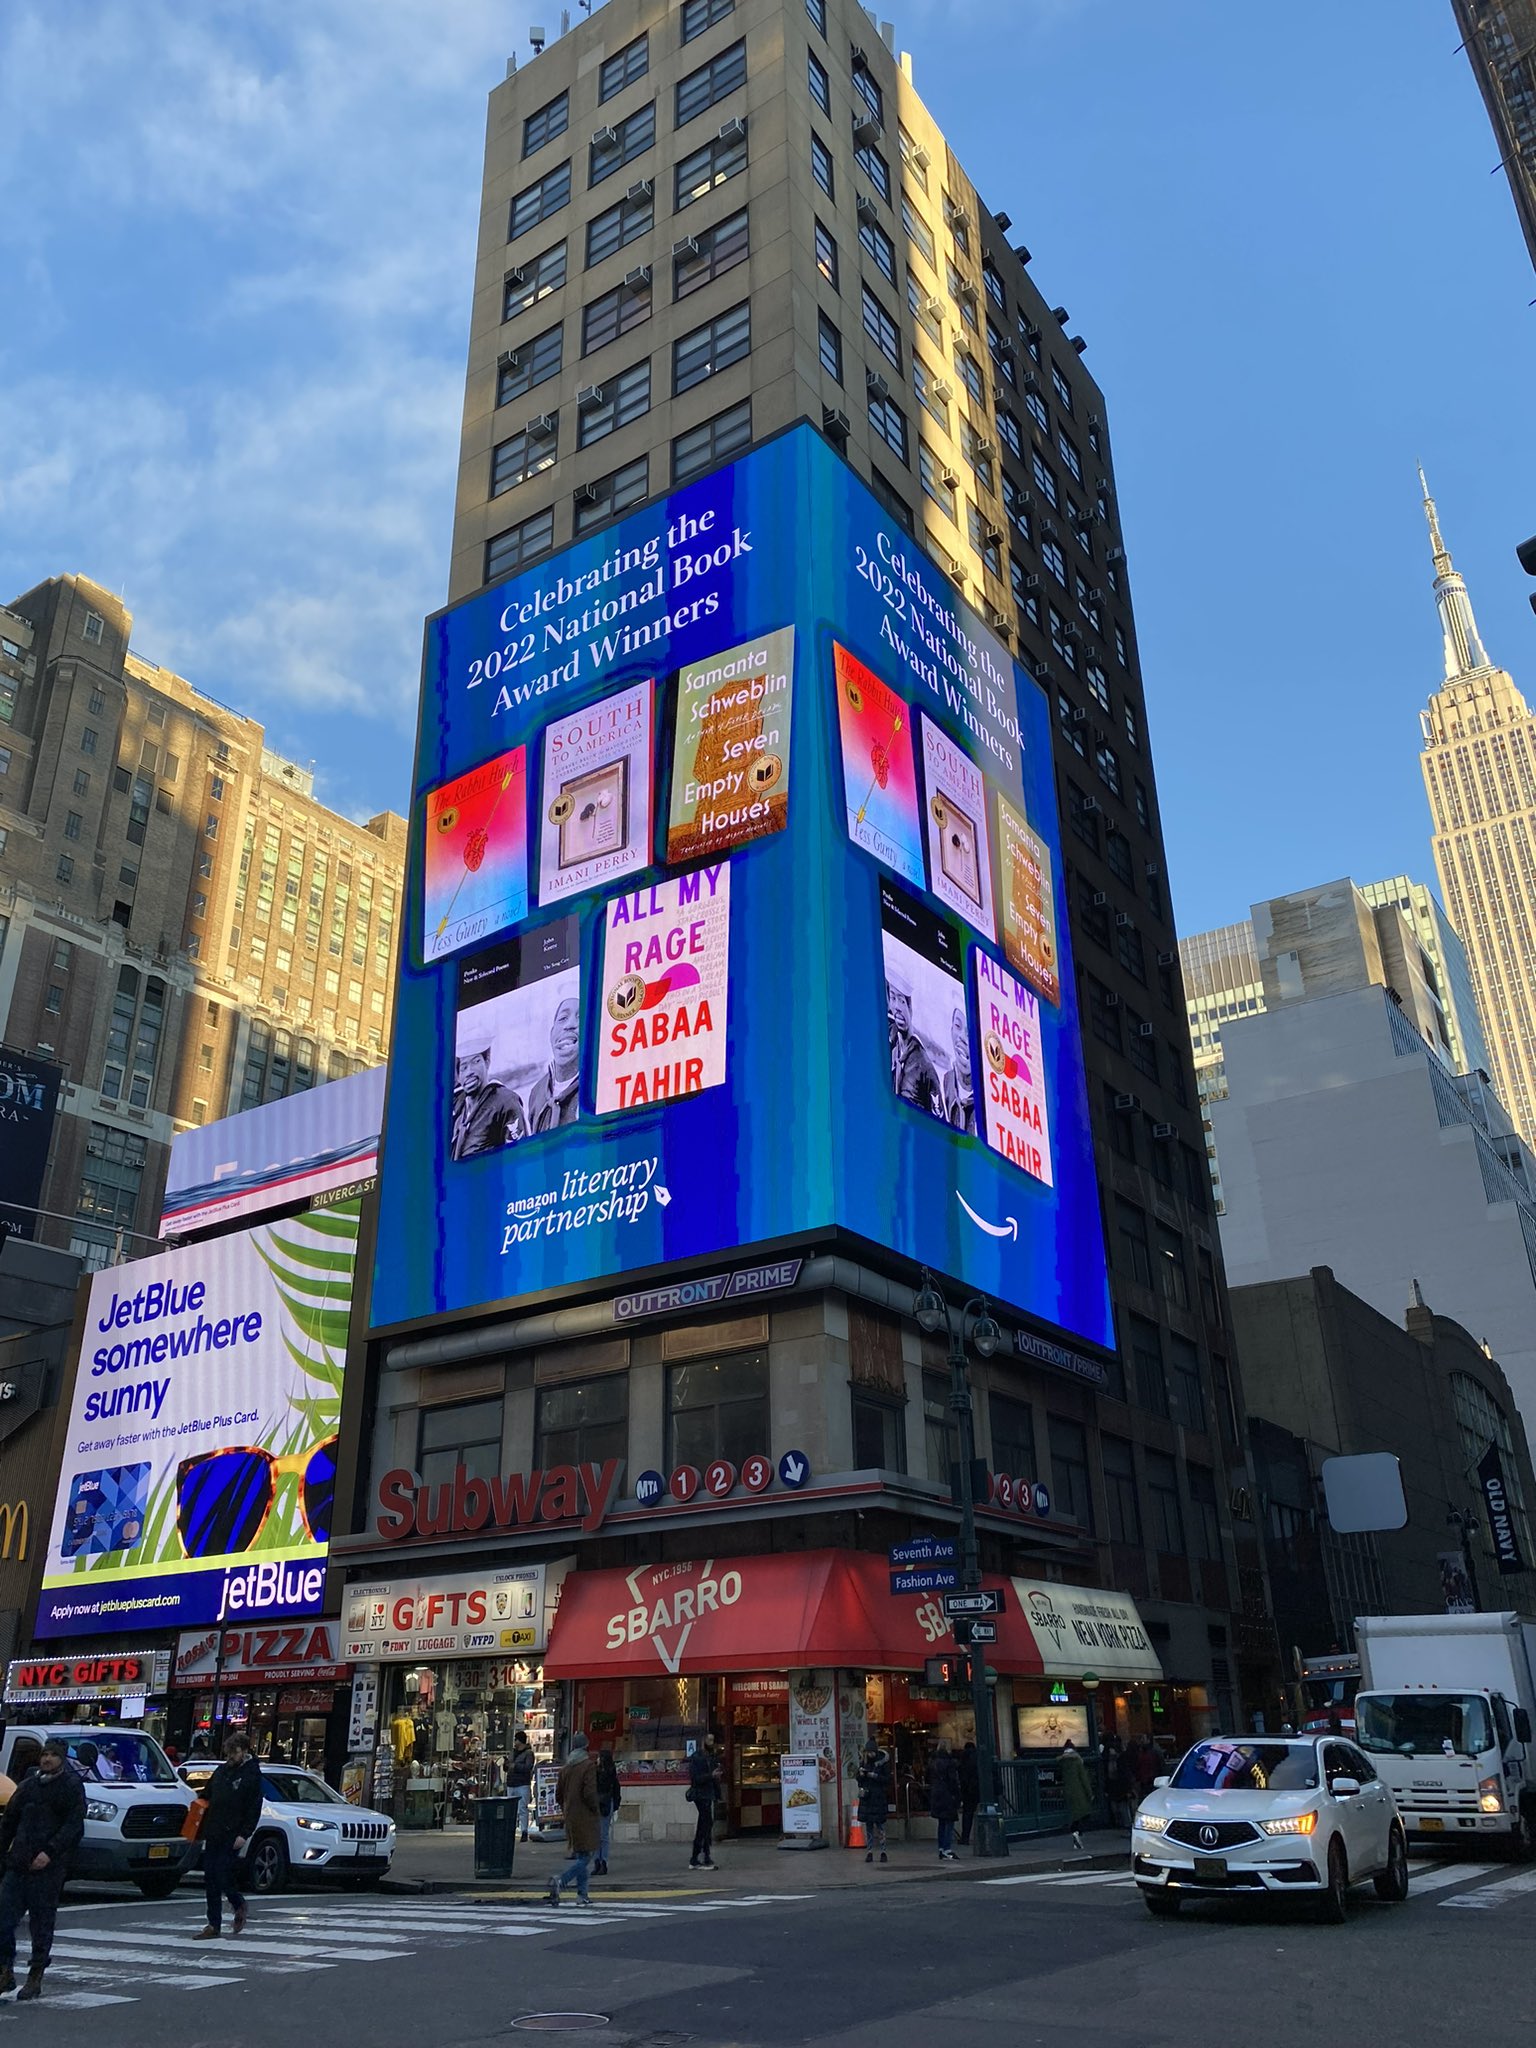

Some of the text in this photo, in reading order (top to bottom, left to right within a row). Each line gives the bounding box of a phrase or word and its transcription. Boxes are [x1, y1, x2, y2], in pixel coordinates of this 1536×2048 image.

[500, 509, 716, 633] Celebrating the
[466, 528, 753, 690] 2022 National Book
[877, 532, 1005, 692] Celebrating the
[491, 590, 719, 717] Award Winners
[840, 652, 855, 675] The
[855, 545, 1025, 751] 2022 National Book
[685, 650, 767, 694] Samanta
[880, 614, 1013, 771] Award Winners
[690, 674, 787, 722] Schweblin
[551, 720, 641, 766] TO AMERICA
[552, 697, 642, 753] SOUTH
[722, 729, 779, 763] Seven
[926, 731, 980, 796] SOUTH
[928, 755, 940, 769] TO
[434, 795, 450, 813] The
[684, 771, 744, 804] Empty
[701, 799, 770, 834] Houses
[1001, 803, 1040, 858] Samanta
[549, 867, 589, 891] IMANI
[595, 848, 638, 873] PERRY
[873, 833, 898, 869] Gunty
[1006, 834, 1051, 895] Schweblin
[612, 884, 664, 928] ALL
[679, 864, 722, 906] MY
[1025, 894, 1051, 934] Seven
[432, 935, 452, 953] Tess
[456, 917, 488, 942] Gunty
[1009, 901, 1038, 945] Empty
[625, 920, 705, 974] RAGE
[1020, 940, 1053, 986] Houses
[980, 952, 1009, 998] ALL
[1014, 981, 1035, 1020] MY
[610, 1000, 713, 1057] SABAA
[990, 1002, 1032, 1060] RAGE
[615, 1057, 703, 1109] TAHIR
[990, 1071, 1042, 1136] SABAA
[996, 1122, 1042, 1180] TAHIR
[314, 1178, 377, 1207] SILVERCAST
[506, 1156, 658, 1215] amazon literary
[500, 1184, 649, 1255] partnership
[98, 1279, 206, 1333] JetBlue
[617, 1265, 792, 1317] OUTFRONT PRIME
[91, 1311, 262, 1377] somewhere
[1022, 1334, 1101, 1380] OUTFRONT PRIME
[83, 1377, 171, 1422] sunny
[78, 1408, 260, 1454] Get away faster with the JetBlue Plus Card.
[78, 1480, 99, 1494] jetBlue
[376, 1458, 625, 1540] Subway
[636, 1461, 764, 1501] MTA 1 2 3
[1002, 1479, 1011, 1502] 2
[1021, 1485, 1030, 1506] 3
[1486, 1477, 1518, 1562] OLD NAVY
[893, 1545, 953, 1560] Seventh Ave
[217, 1562, 323, 1621] jetBlue
[352, 1586, 387, 1596] ELECTRONICS
[495, 1571, 536, 1582] UNLOCK PHONES
[896, 1574, 955, 1589] Fashion Ave
[50, 1594, 180, 1619] Apply now at jetbluepluscard.com
[371, 1615, 385, 1627] NY
[392, 1589, 487, 1631] GIFTS
[605, 1570, 742, 1650] SBARRO
[953, 1598, 989, 1608] ONE WAY
[1031, 1611, 1066, 1629] SBARRO
[223, 1626, 335, 1668] PIZZA
[359, 1643, 374, 1655] NY
[389, 1631, 531, 1653] FDNY LUGGAGE NYPD TAXI
[1071, 1620, 1150, 1650] NEW YORK PIZZA
[18, 1663, 65, 1687] NYC
[74, 1659, 139, 1683] GIFTS
[186, 1675, 207, 1684] DELIVERY
[265, 1669, 315, 1679] PROUDLY SERVING
[732, 1681, 768, 1691] WELCOME TO
[820, 1717, 829, 1725] PIE
